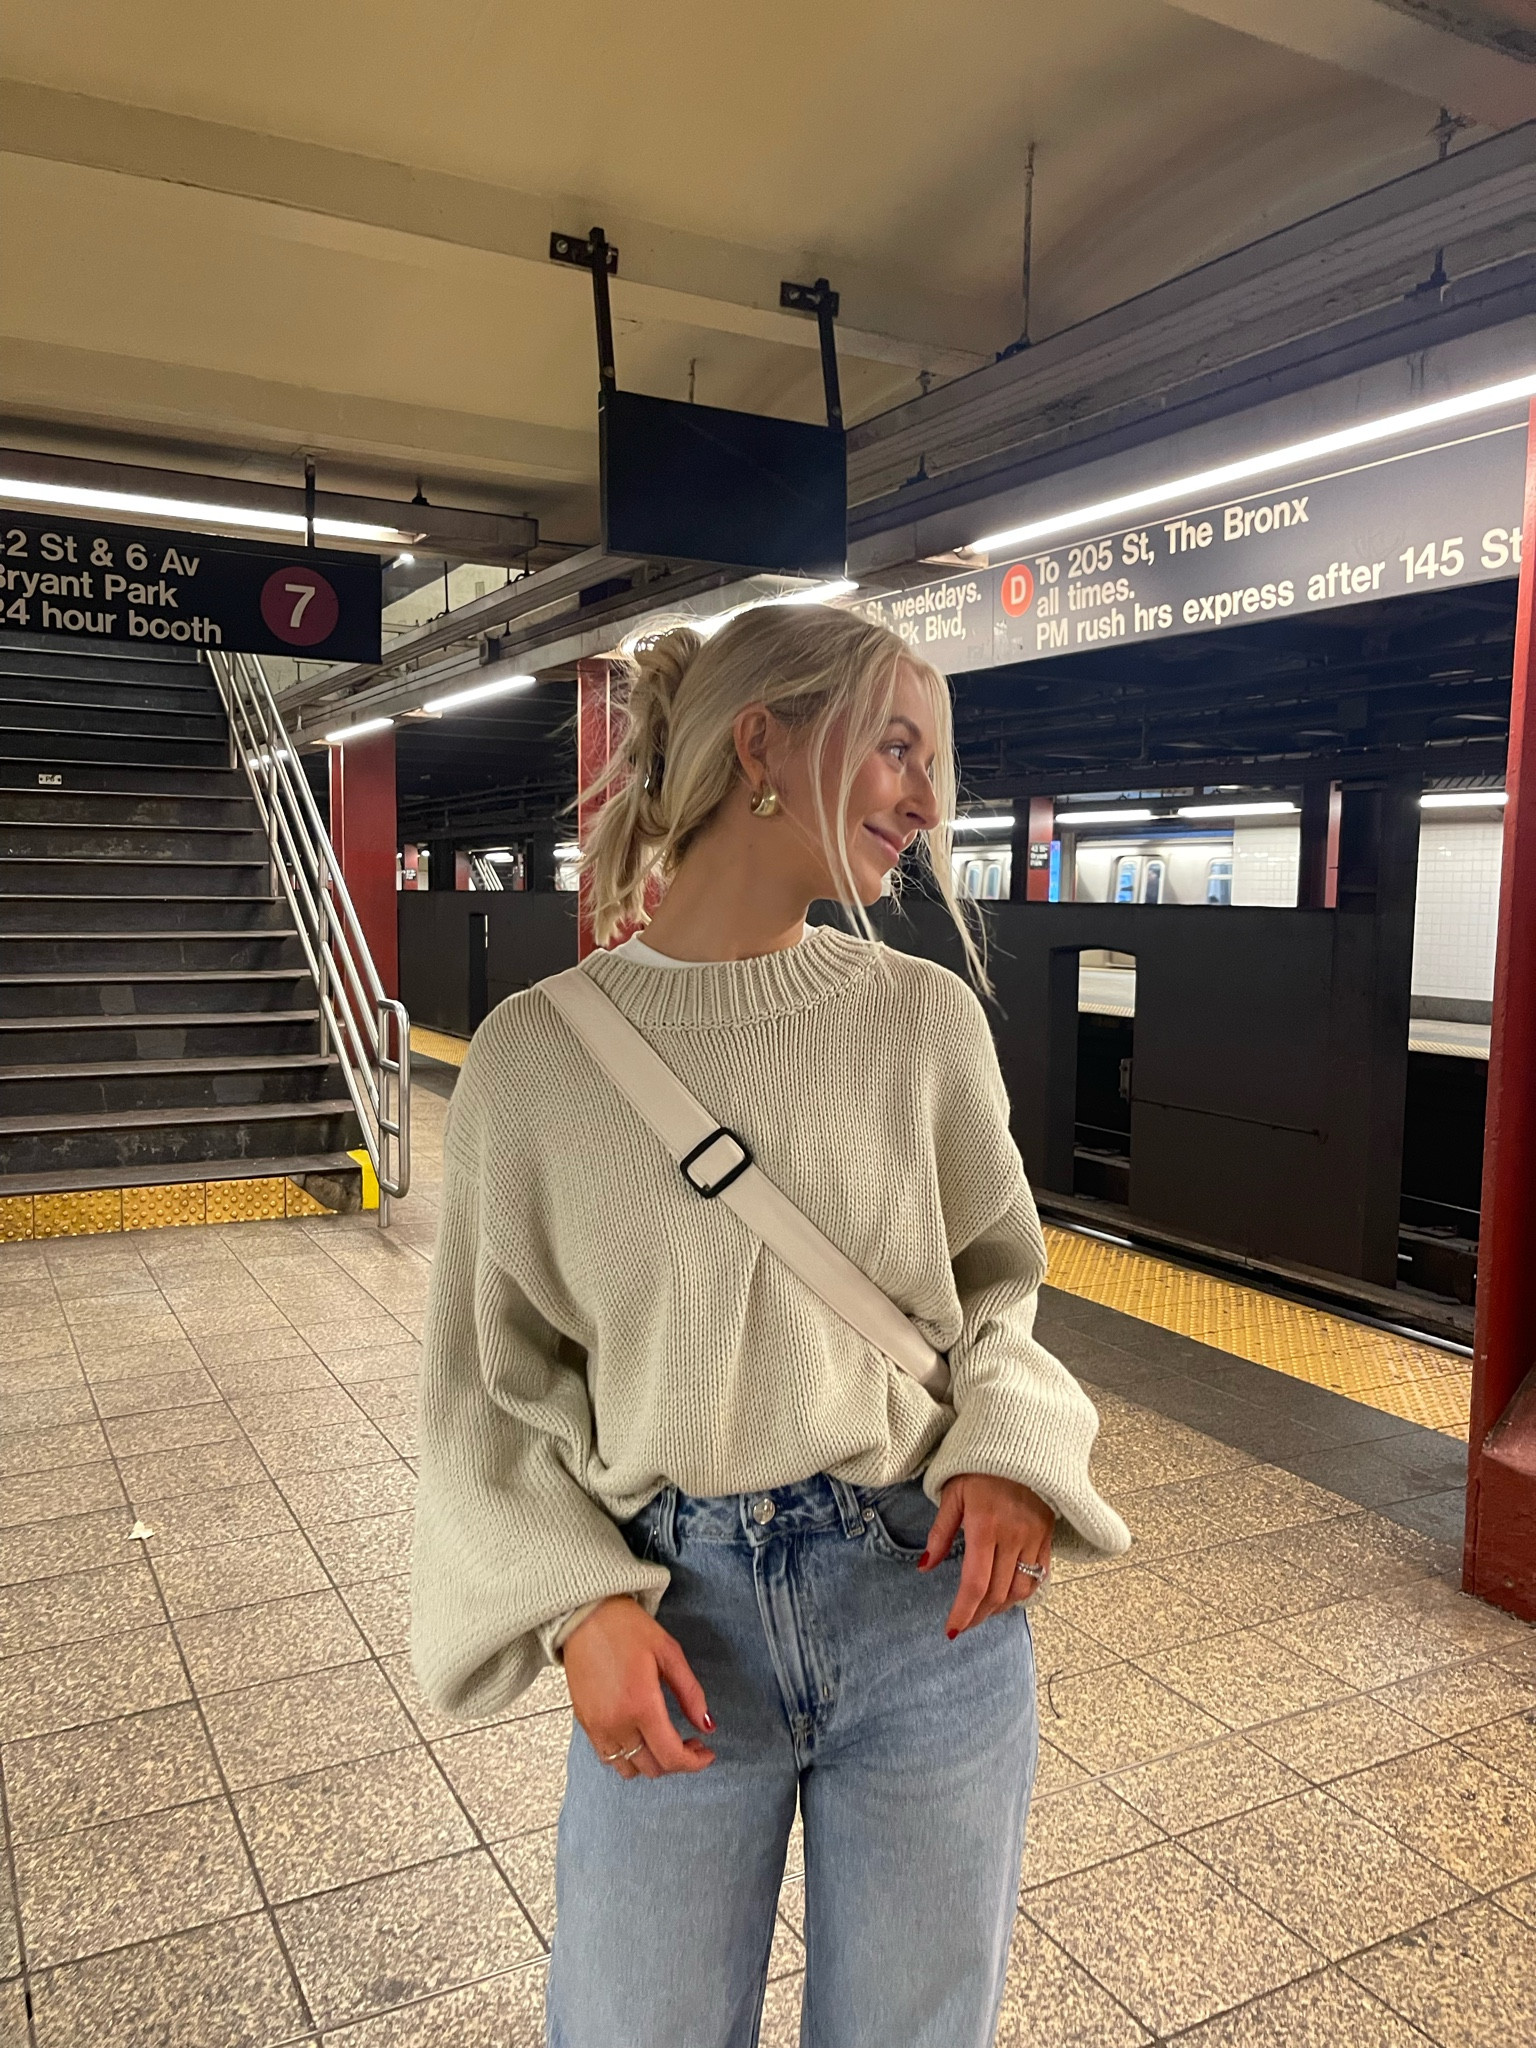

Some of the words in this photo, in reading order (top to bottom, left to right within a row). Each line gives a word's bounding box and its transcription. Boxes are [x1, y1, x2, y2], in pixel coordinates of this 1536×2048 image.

[0, 528, 28, 558] 2
[40, 532, 79, 563] St
[90, 538, 114, 567] &
[126, 543, 148, 571] 6
[160, 548, 200, 576] Av
[1035, 556, 1060, 586] To
[1068, 540, 1113, 579] 205
[1121, 532, 1155, 566] St,
[1164, 519, 1214, 555] The
[1223, 497, 1310, 541] Bronx
[0, 563, 94, 598] ryant
[104, 573, 179, 608] Park
[284, 583, 316, 628] 7
[891, 582, 982, 620] weekdays.
[1010, 575, 1027, 606] D
[1036, 618, 1069, 651] PM
[1077, 608, 1126, 643] rush
[1134, 601, 1173, 633] hrs
[1182, 579, 1295, 625] express
[1307, 562, 1386, 602] after
[1399, 536, 1465, 584] 145
[1480, 527, 1523, 569] St
[1036, 587, 1059, 618] all
[1068, 577, 1136, 611] times.
[0, 598, 31, 626] 4
[42, 601, 118, 634] hour
[128, 609, 222, 645] booth
[925, 610, 967, 641] Blvd,
